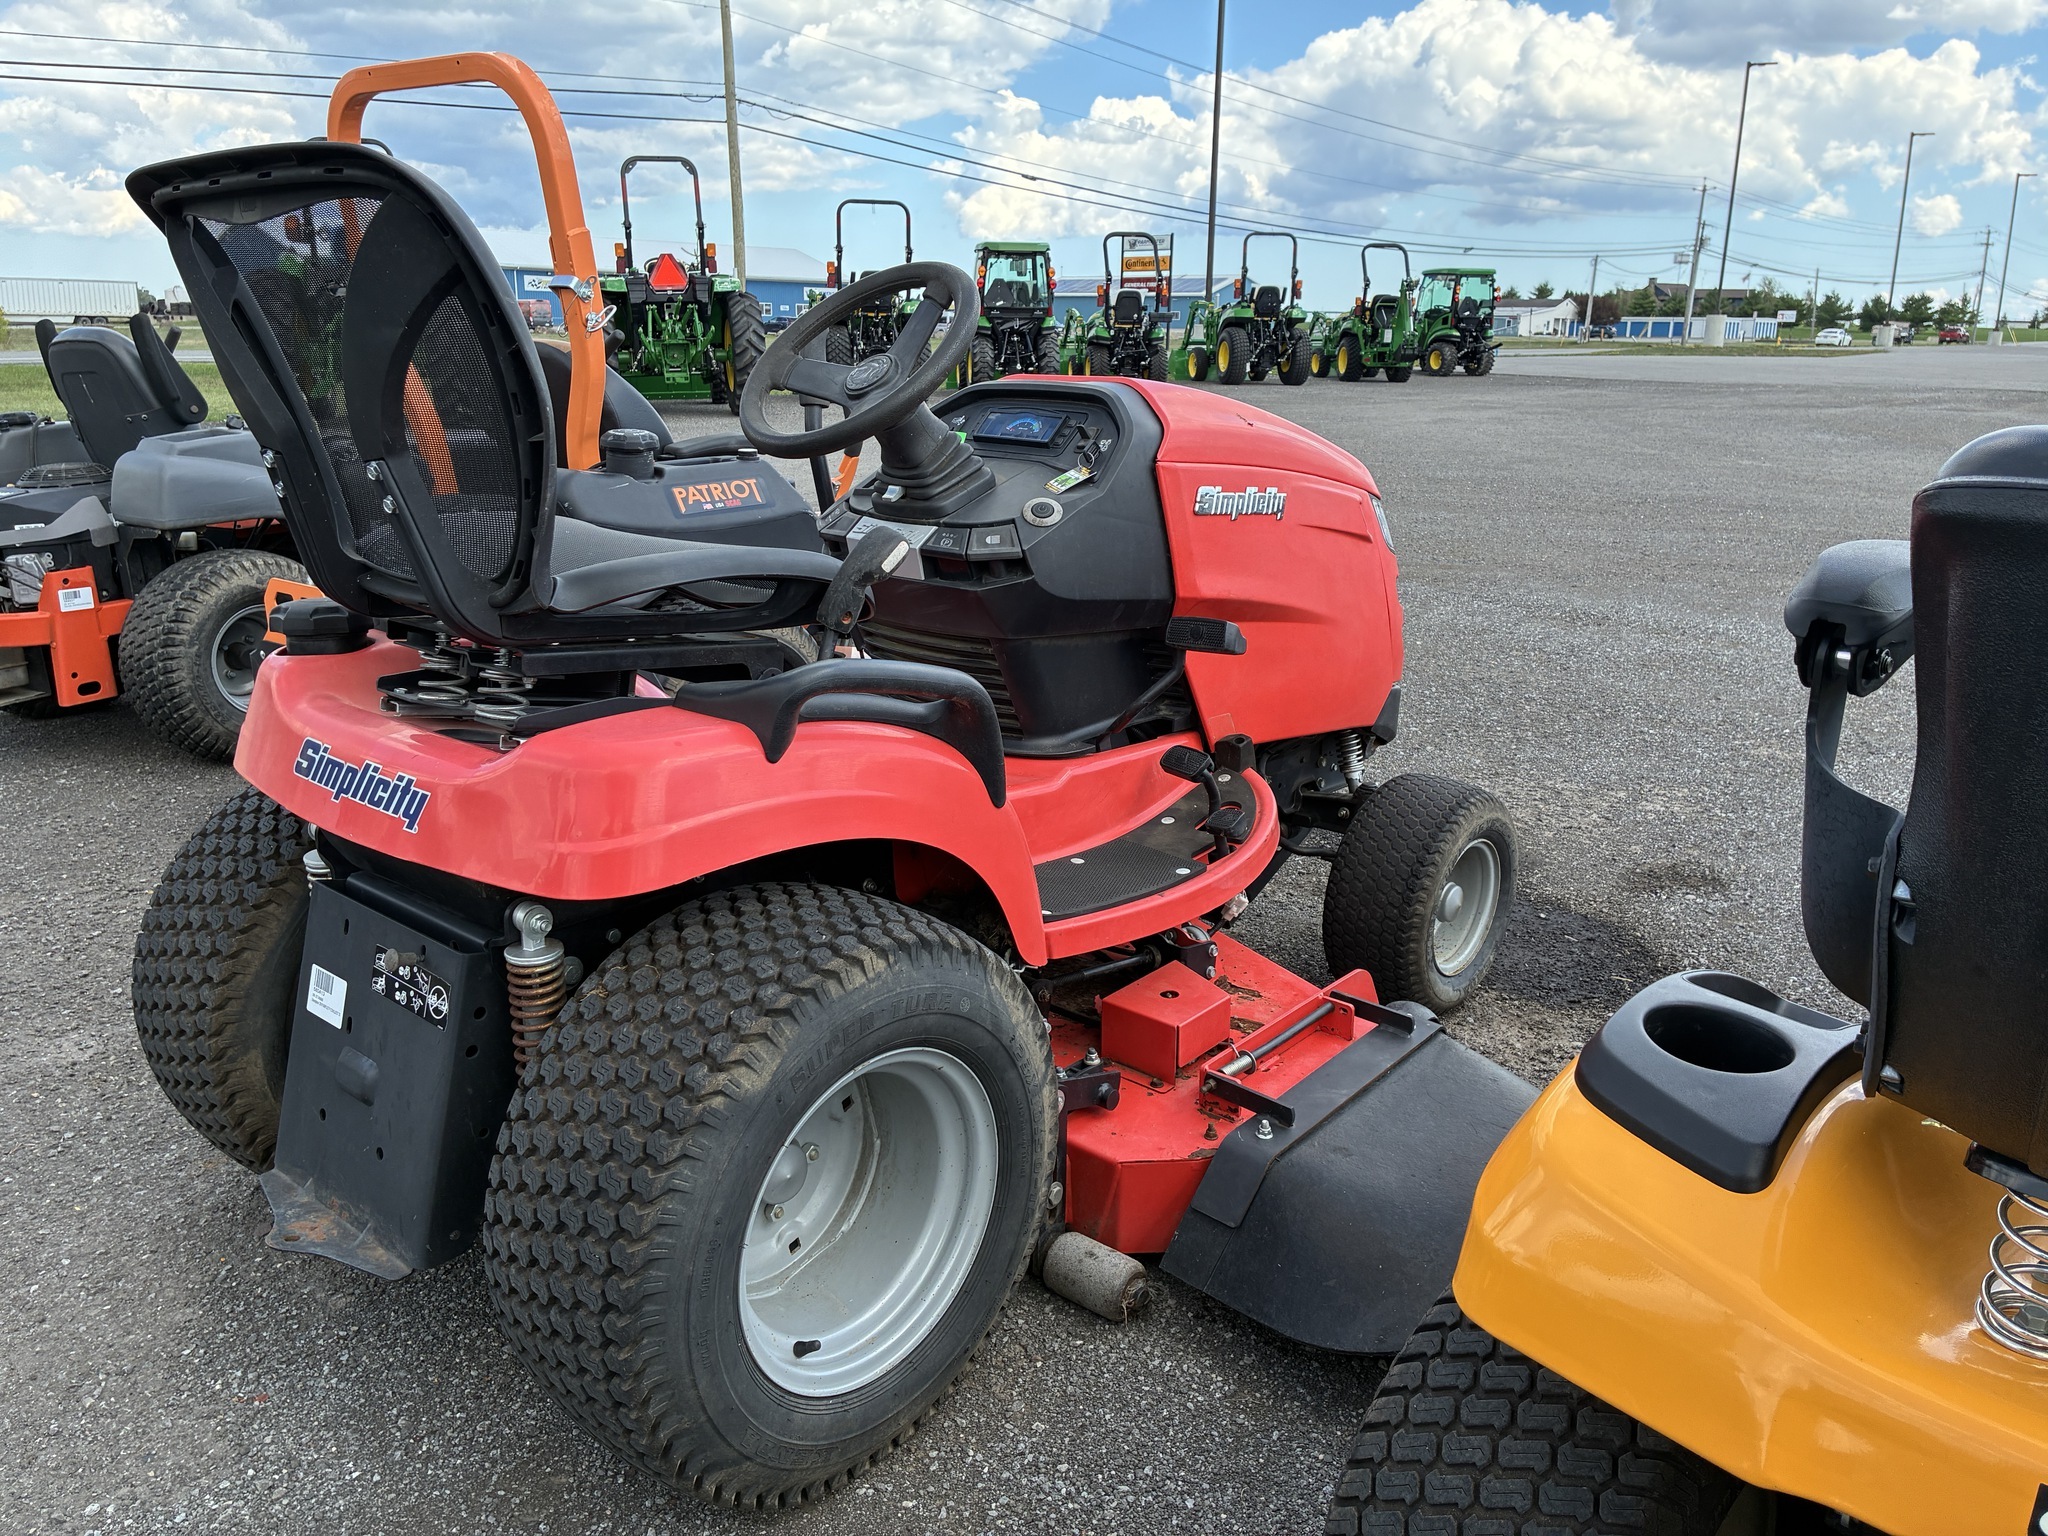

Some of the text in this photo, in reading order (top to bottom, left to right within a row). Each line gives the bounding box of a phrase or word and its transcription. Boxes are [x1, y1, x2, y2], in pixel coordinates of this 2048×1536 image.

[1125, 259, 1155, 269] Continent
[672, 478, 762, 514] PATRIOT
[1194, 486, 1287, 521] Simplicity
[294, 737, 431, 832] Simplicity
[790, 992, 953, 1095] SUPER TURF
